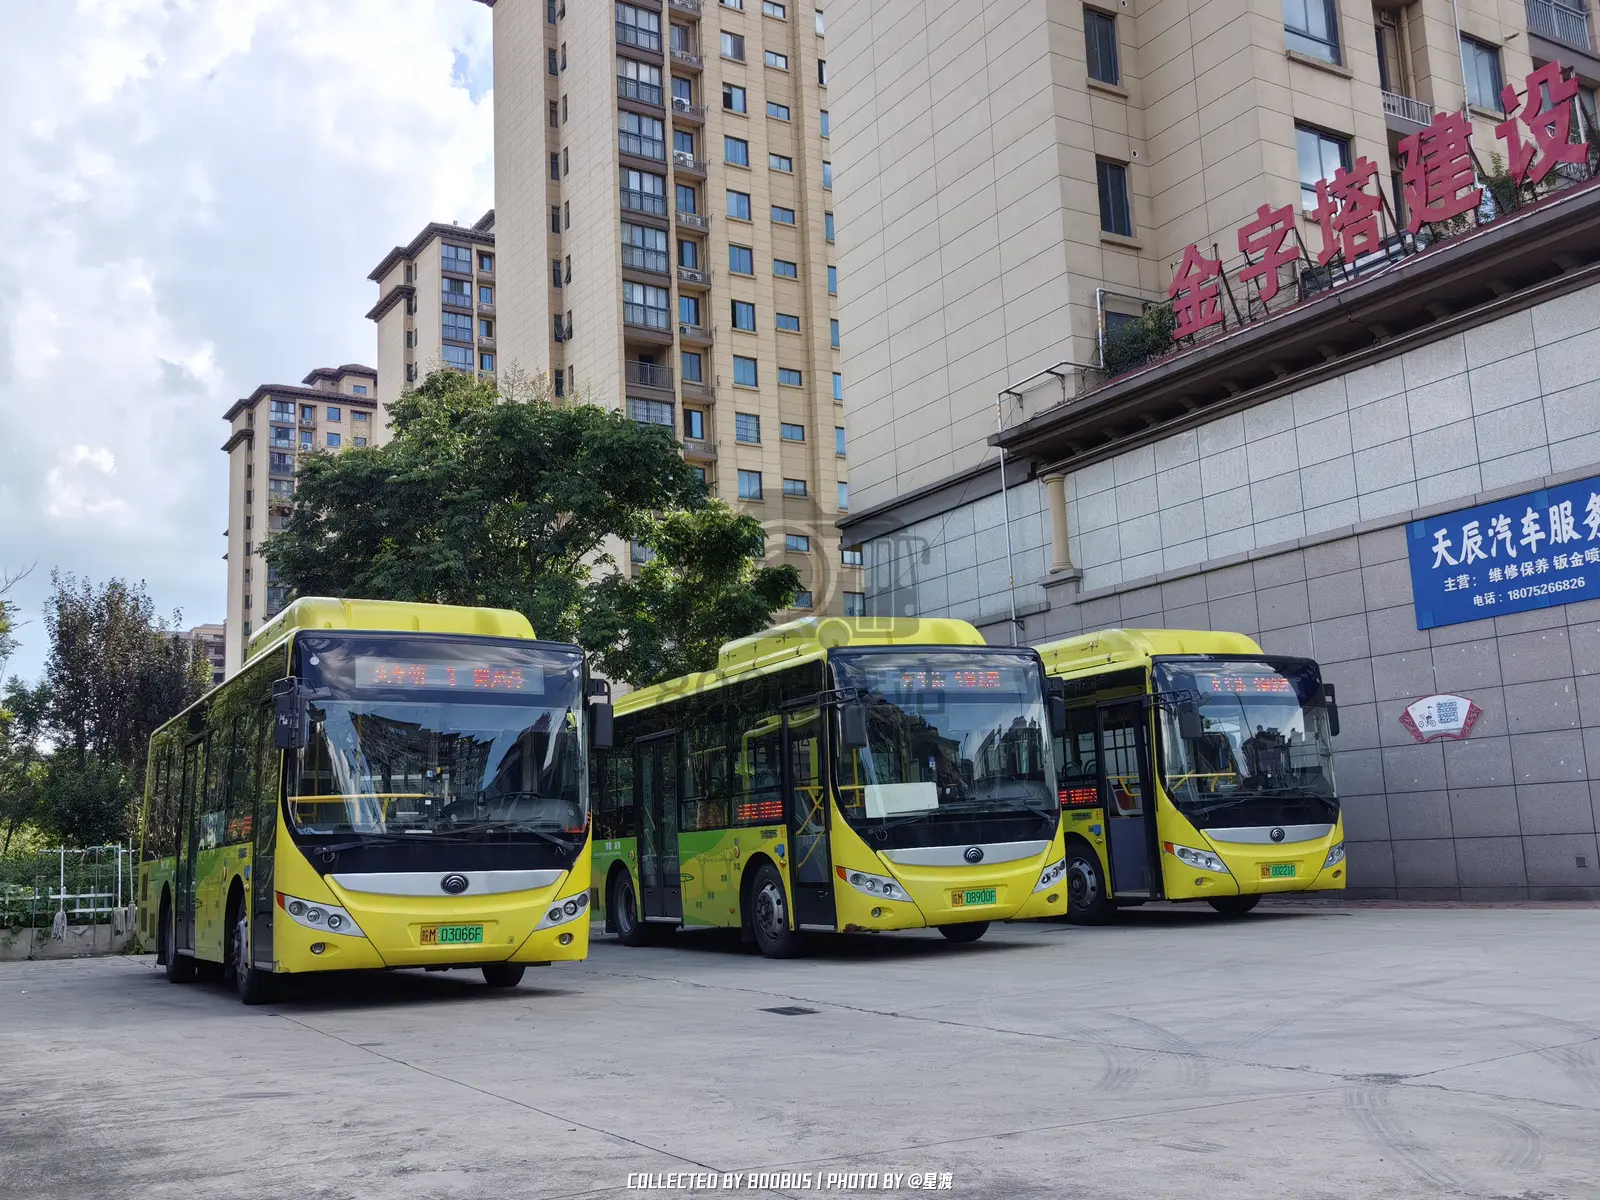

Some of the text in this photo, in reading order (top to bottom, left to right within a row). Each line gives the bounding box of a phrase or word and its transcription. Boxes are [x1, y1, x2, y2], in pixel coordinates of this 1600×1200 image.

[1168, 60, 1589, 340] 金字塔建设
